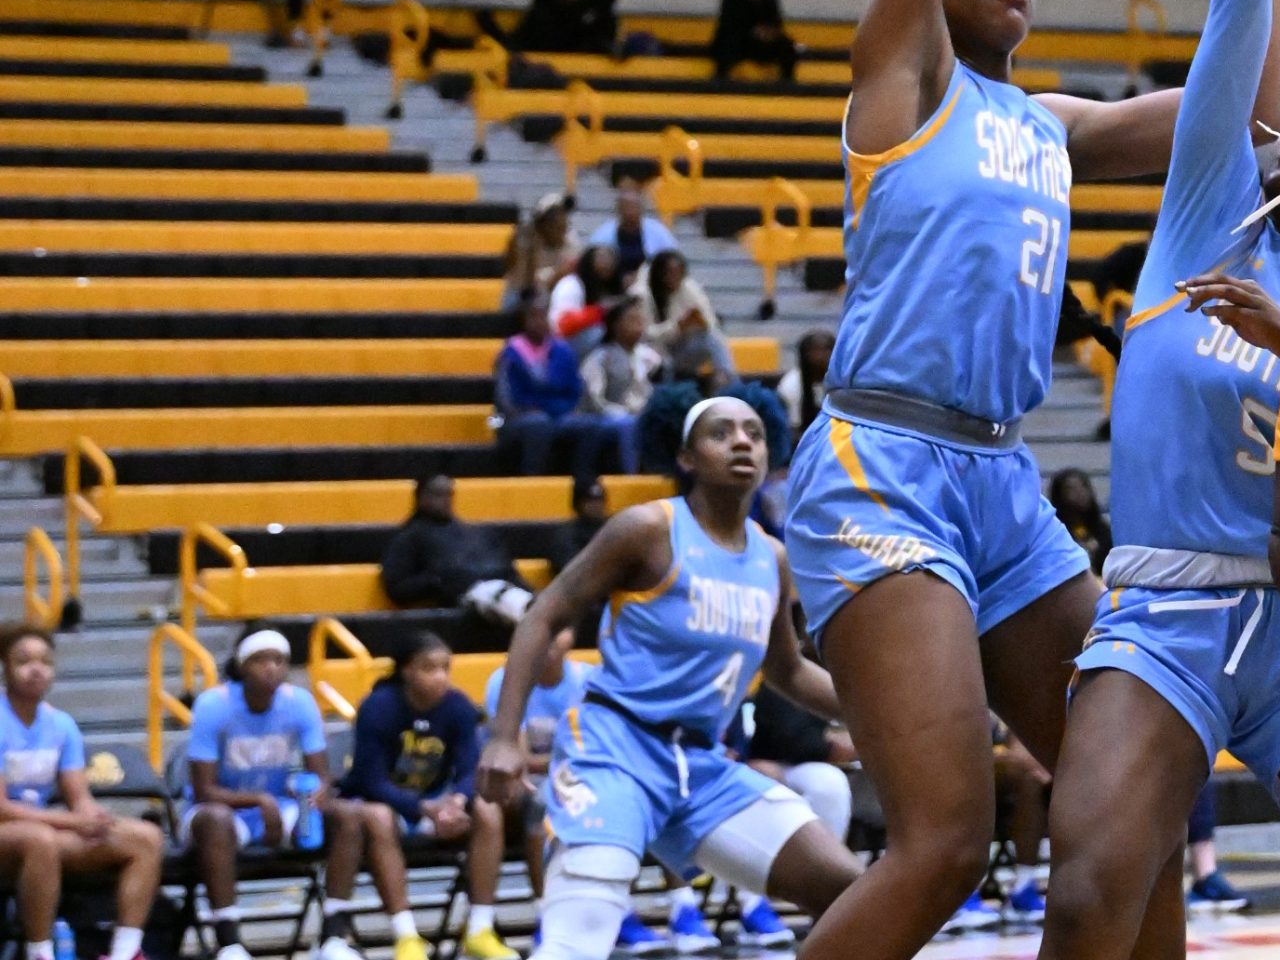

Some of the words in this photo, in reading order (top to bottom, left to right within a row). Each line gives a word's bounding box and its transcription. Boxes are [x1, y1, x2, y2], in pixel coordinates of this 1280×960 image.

[1020, 207, 1062, 294] 21
[1236, 396, 1276, 475] 5
[714, 651, 744, 706] 4
